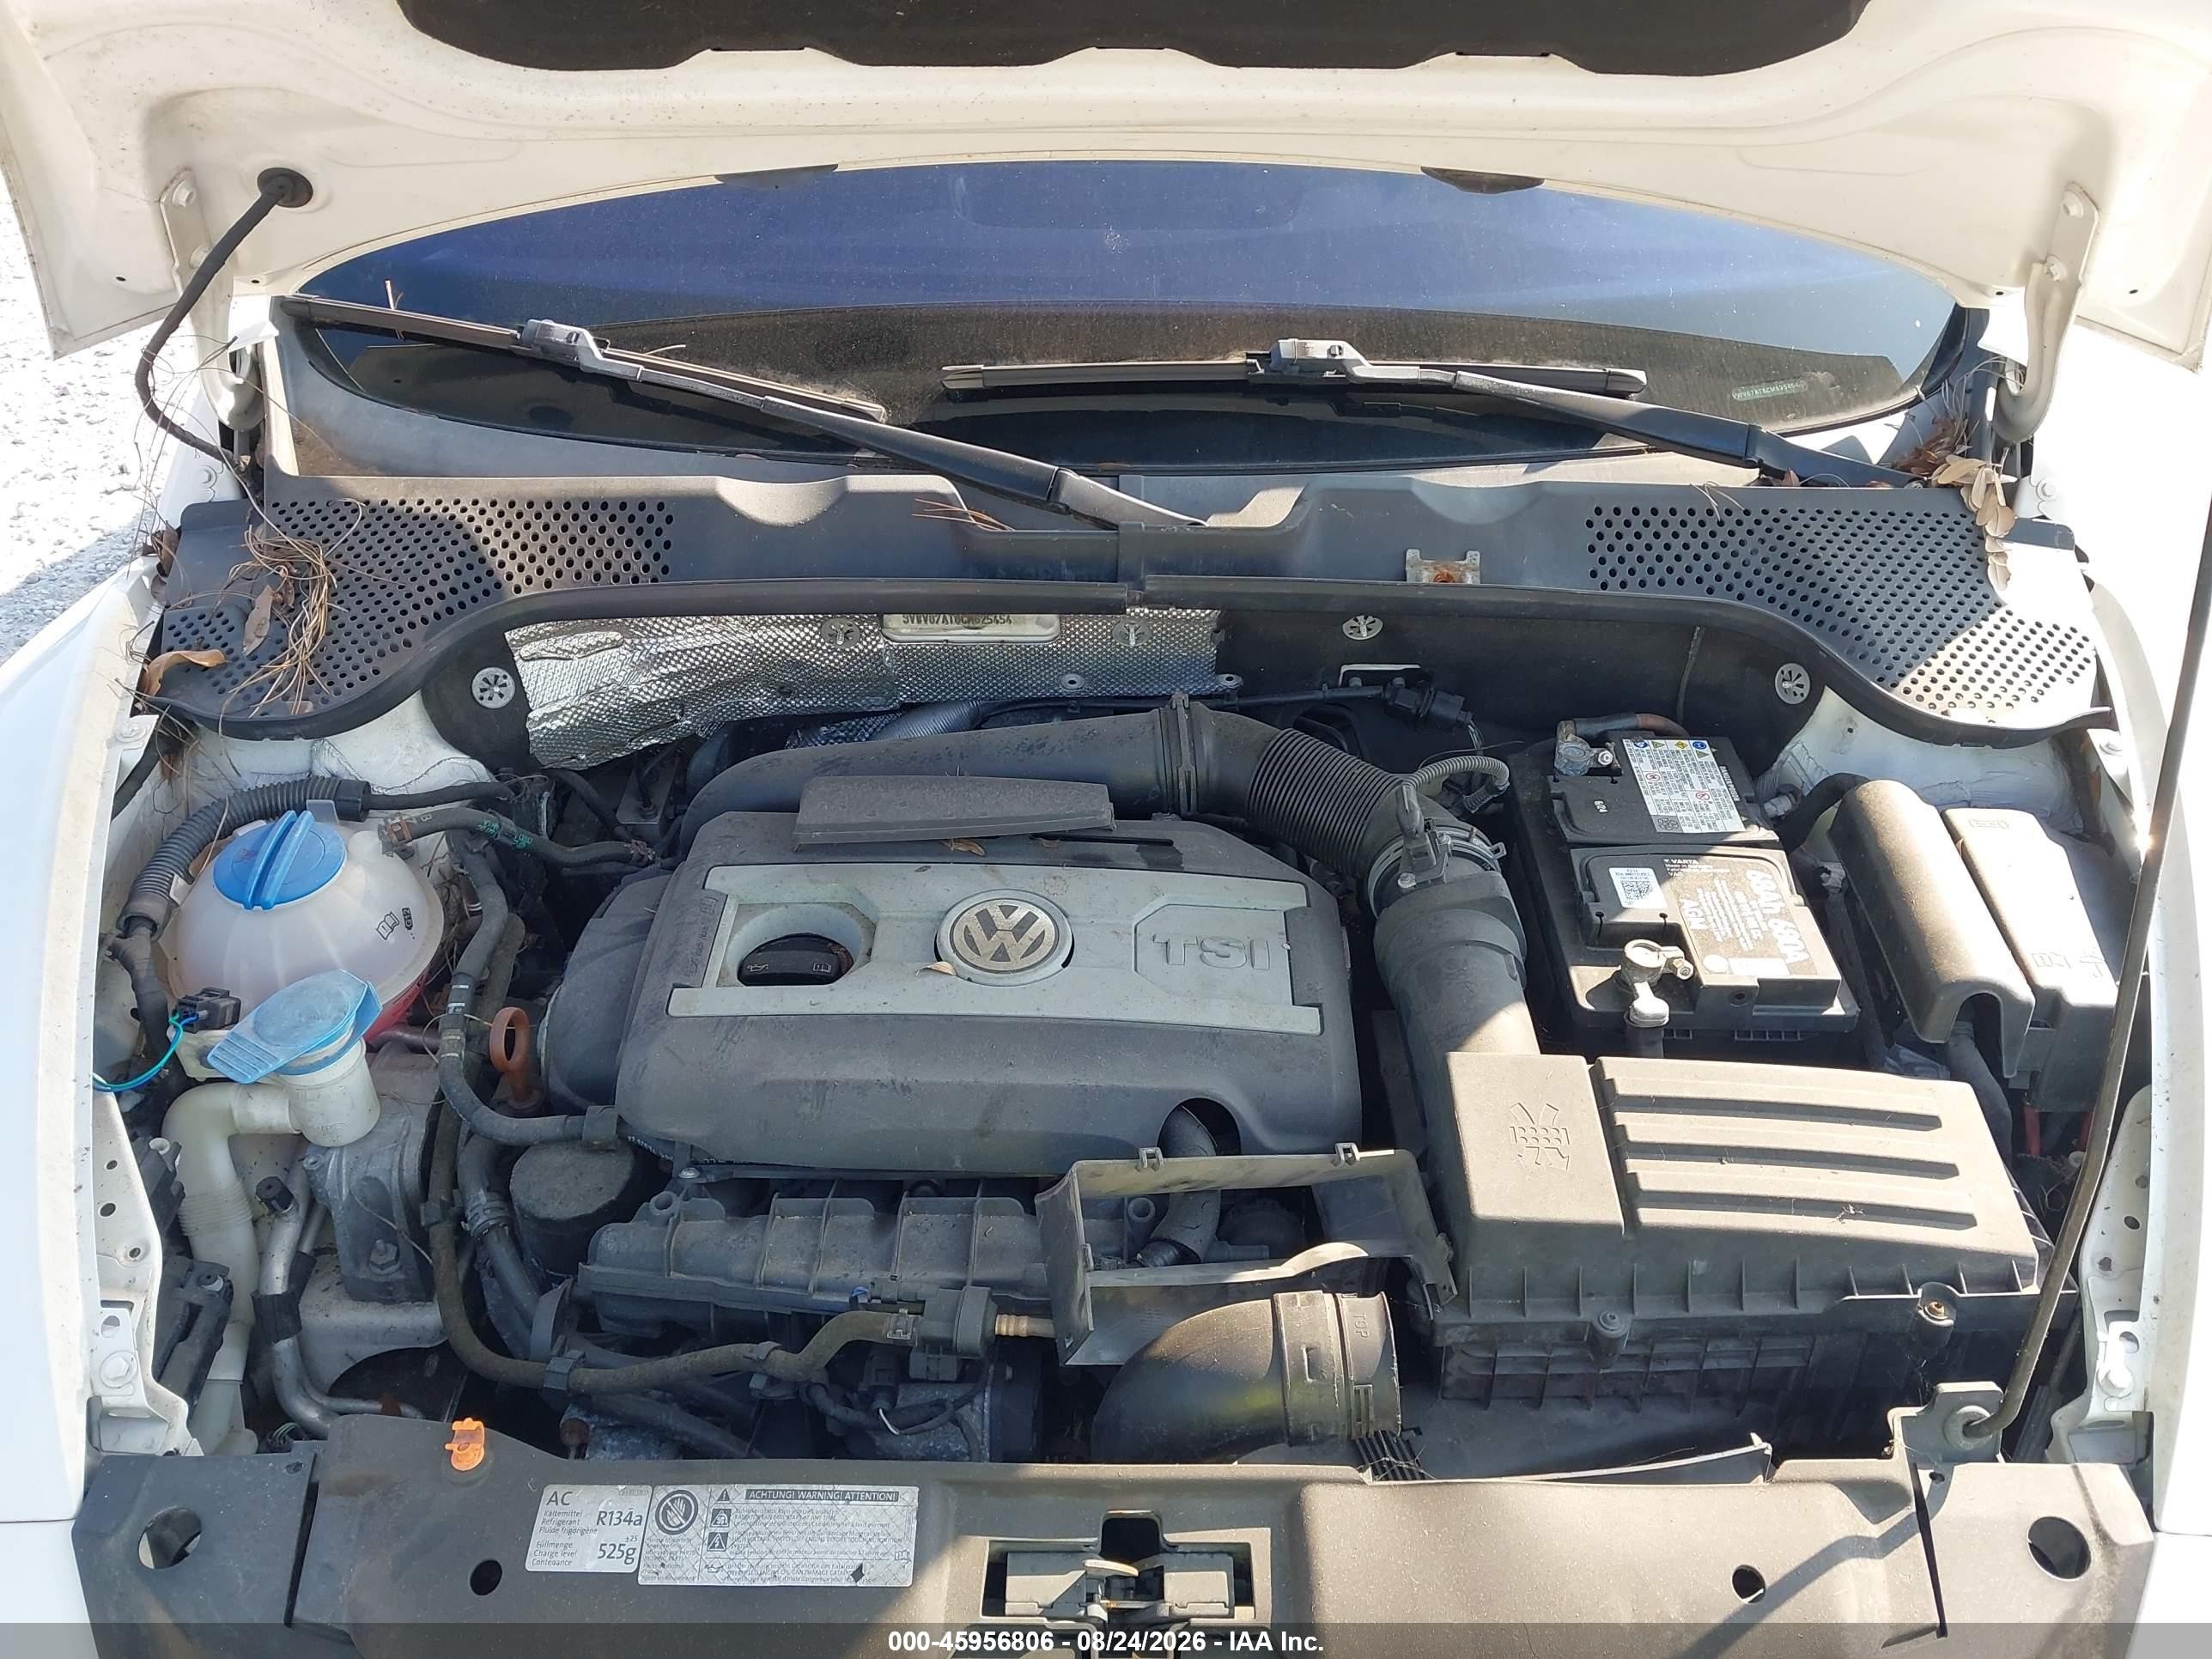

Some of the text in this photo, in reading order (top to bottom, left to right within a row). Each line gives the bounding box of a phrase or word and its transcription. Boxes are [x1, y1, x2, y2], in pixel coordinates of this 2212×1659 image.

[1152, 933, 1271, 971] TSI
[1352, 1313, 1368, 1339] TOP
[546, 1491, 573, 1506] AC
[749, 1490, 896, 1501] ACHTUNG! WARNING! ATTENTION!
[541, 1518, 580, 1527] Refrigerant
[596, 1510, 643, 1526] R134a
[533, 1549, 558, 1559] Charge
[598, 1543, 637, 1565] 525g
